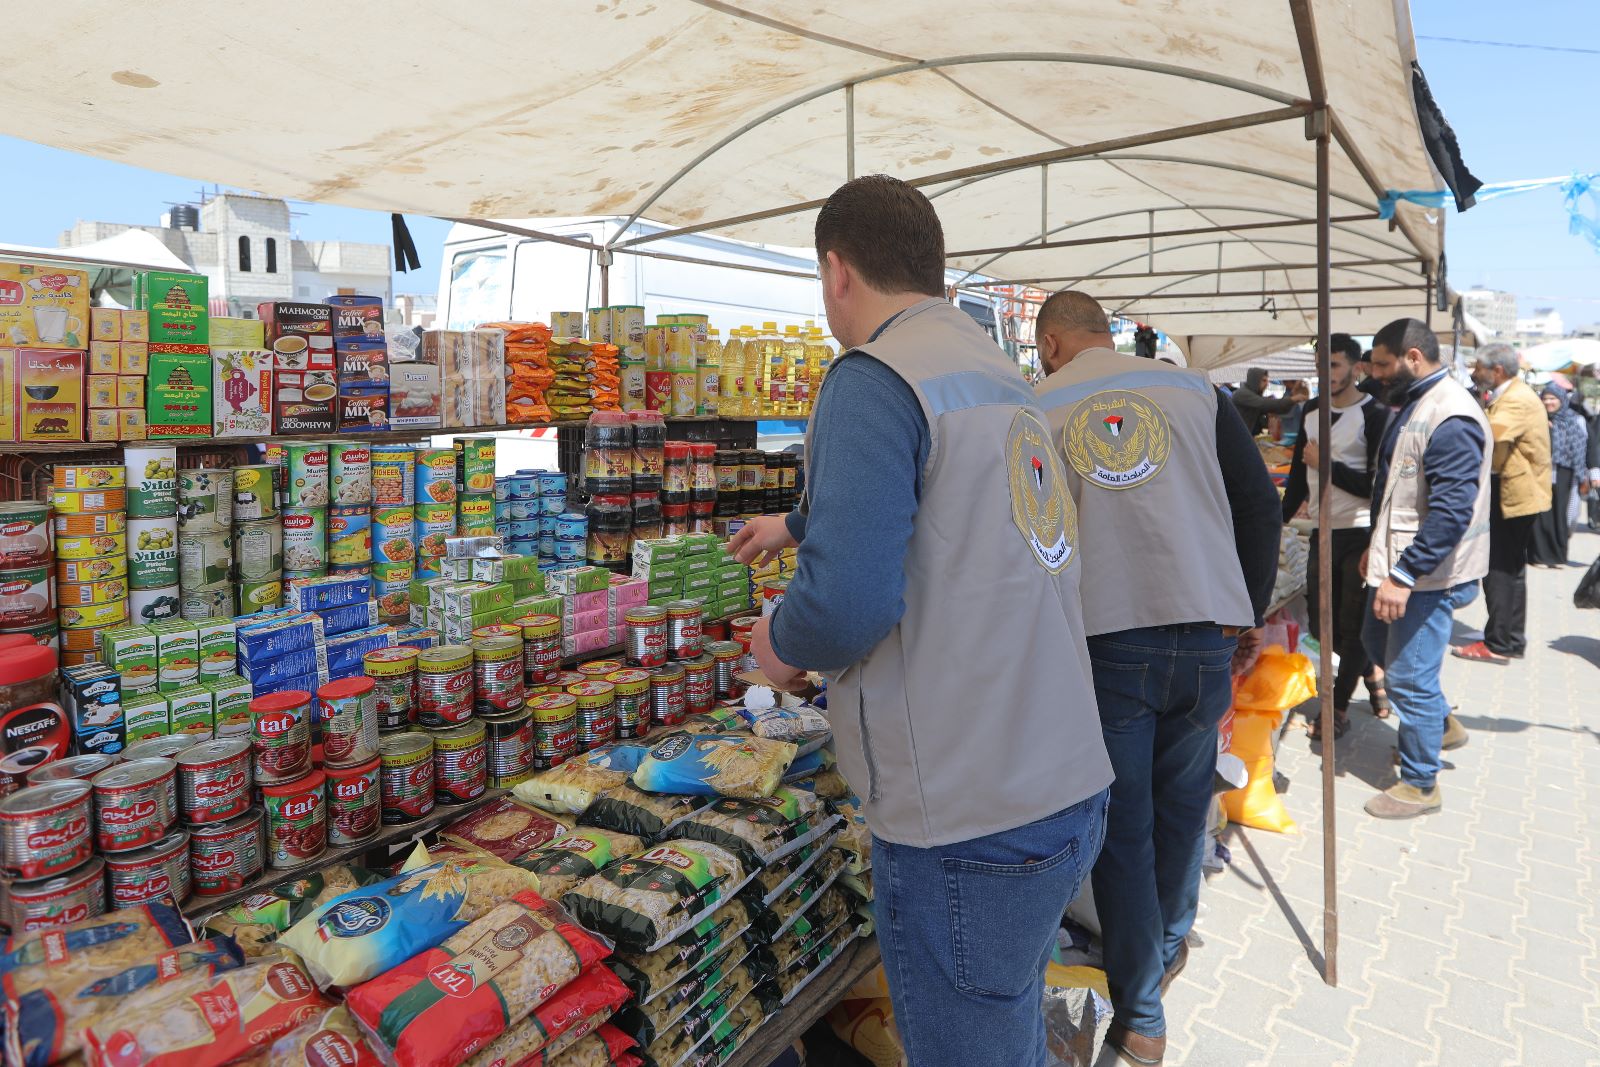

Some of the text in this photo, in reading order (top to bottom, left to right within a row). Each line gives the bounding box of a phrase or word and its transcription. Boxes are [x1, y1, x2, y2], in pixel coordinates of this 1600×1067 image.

[279, 306, 329, 316] MAHMOOD
[341, 309, 363, 317] Coffee
[338, 316, 366, 327] MIX
[345, 354, 369, 363] Coffee
[343, 361, 371, 371] MIX
[260, 371, 268, 389] Royal
[347, 399, 370, 407] Coffee
[1093, 398, 1126, 411] الشرطة
[344, 407, 371, 417] MIX
[229, 419, 234, 429] 50
[1097, 470, 1121, 483] العامة
[1, 523, 29, 534] yummy
[536, 651, 560, 663] PIONEE
[320, 705, 331, 718] at
[259, 716, 291, 734] tat
[24, 733, 44, 744] FORTE
[336, 779, 365, 797] tat
[284, 796, 315, 818] tat
[432, 969, 466, 994] TAT
[541, 985, 557, 998] TAT
[567, 1007, 583, 1019] TAT
[575, 1023, 591, 1036] TAT
[463, 1039, 480, 1054] TAT
